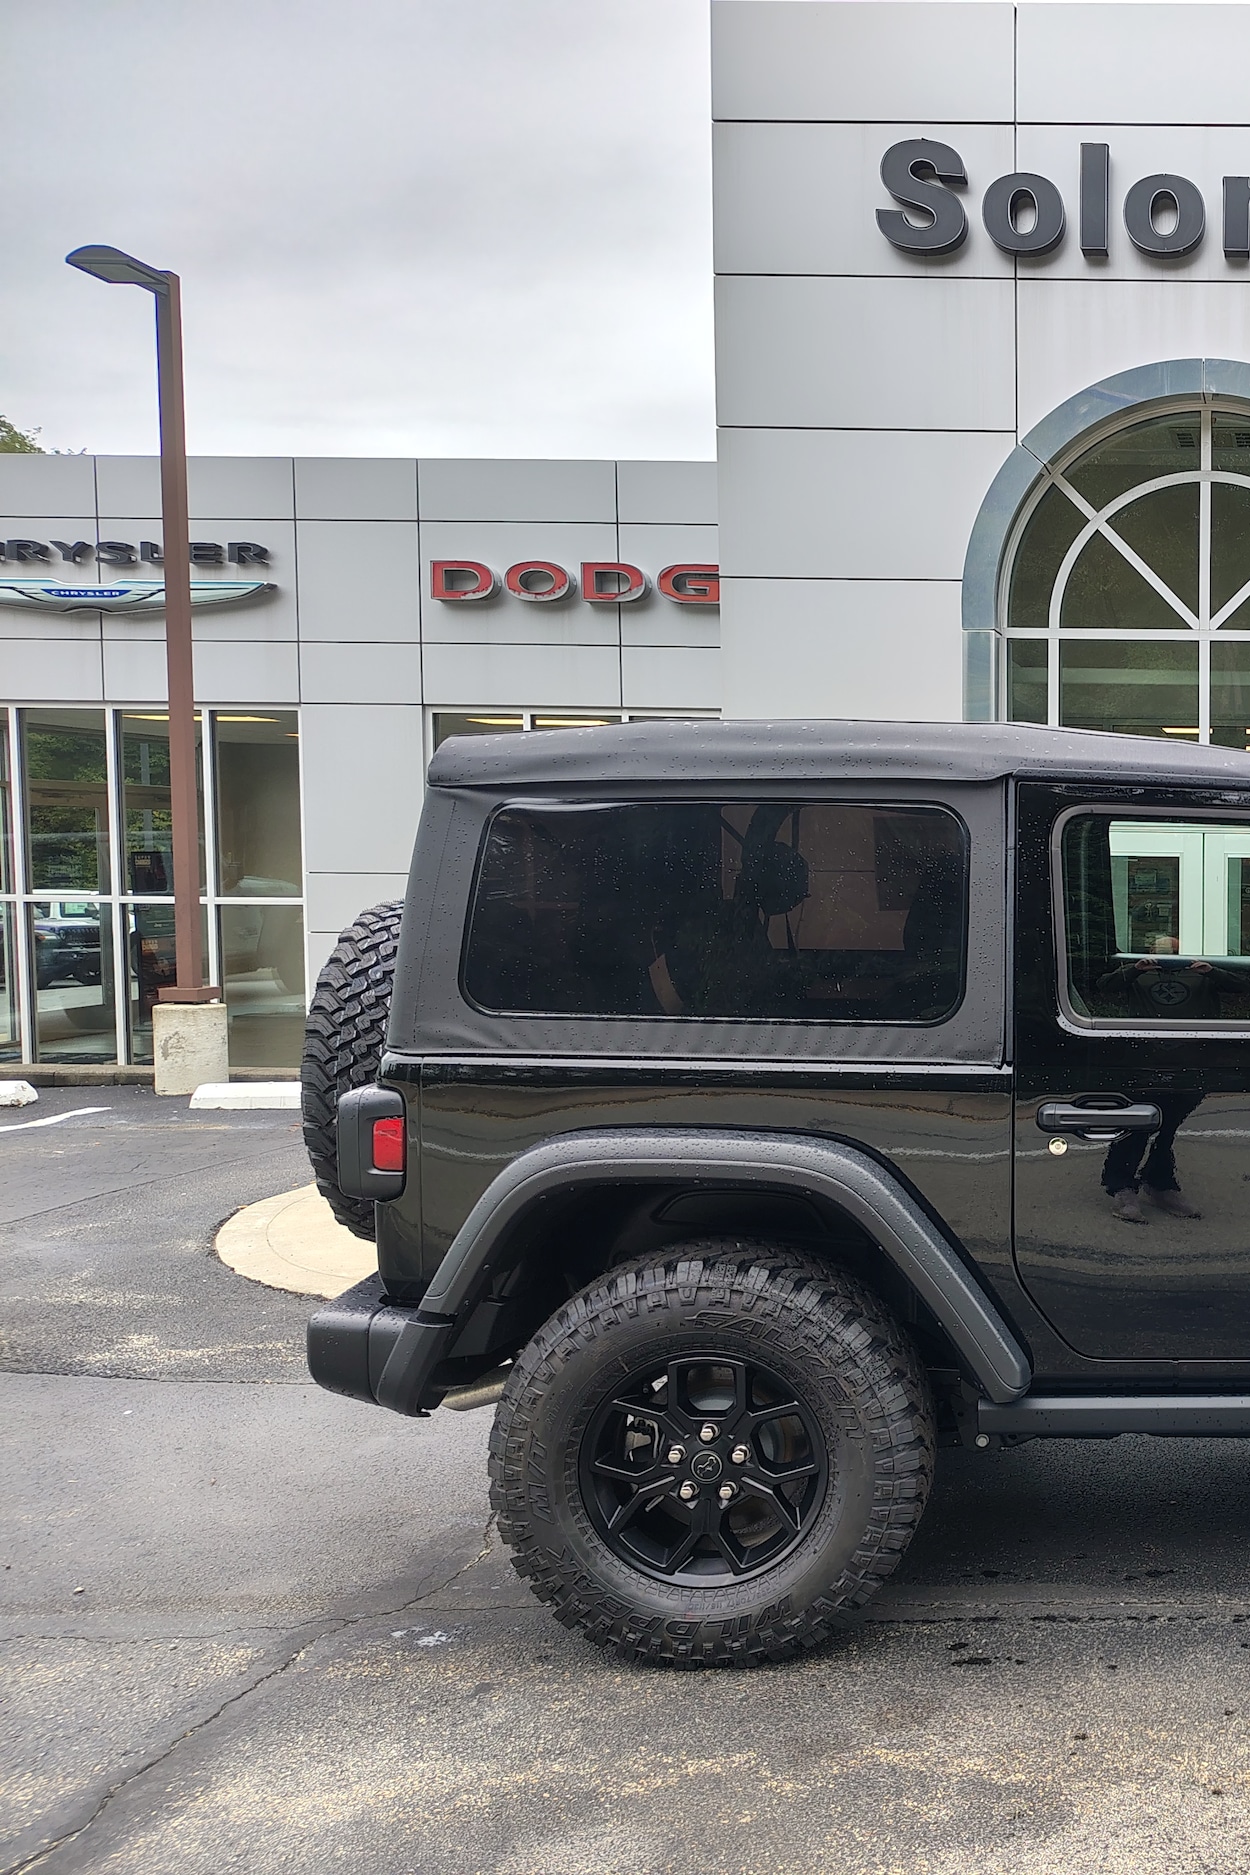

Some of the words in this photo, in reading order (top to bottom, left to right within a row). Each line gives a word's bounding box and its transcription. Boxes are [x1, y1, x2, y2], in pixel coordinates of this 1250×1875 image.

[0, 539, 269, 565] RYSLER
[51, 590, 120, 598] CHRYSLER
[430, 560, 720, 605] DODG
[545, 1545, 794, 1639] WILDPEAK
